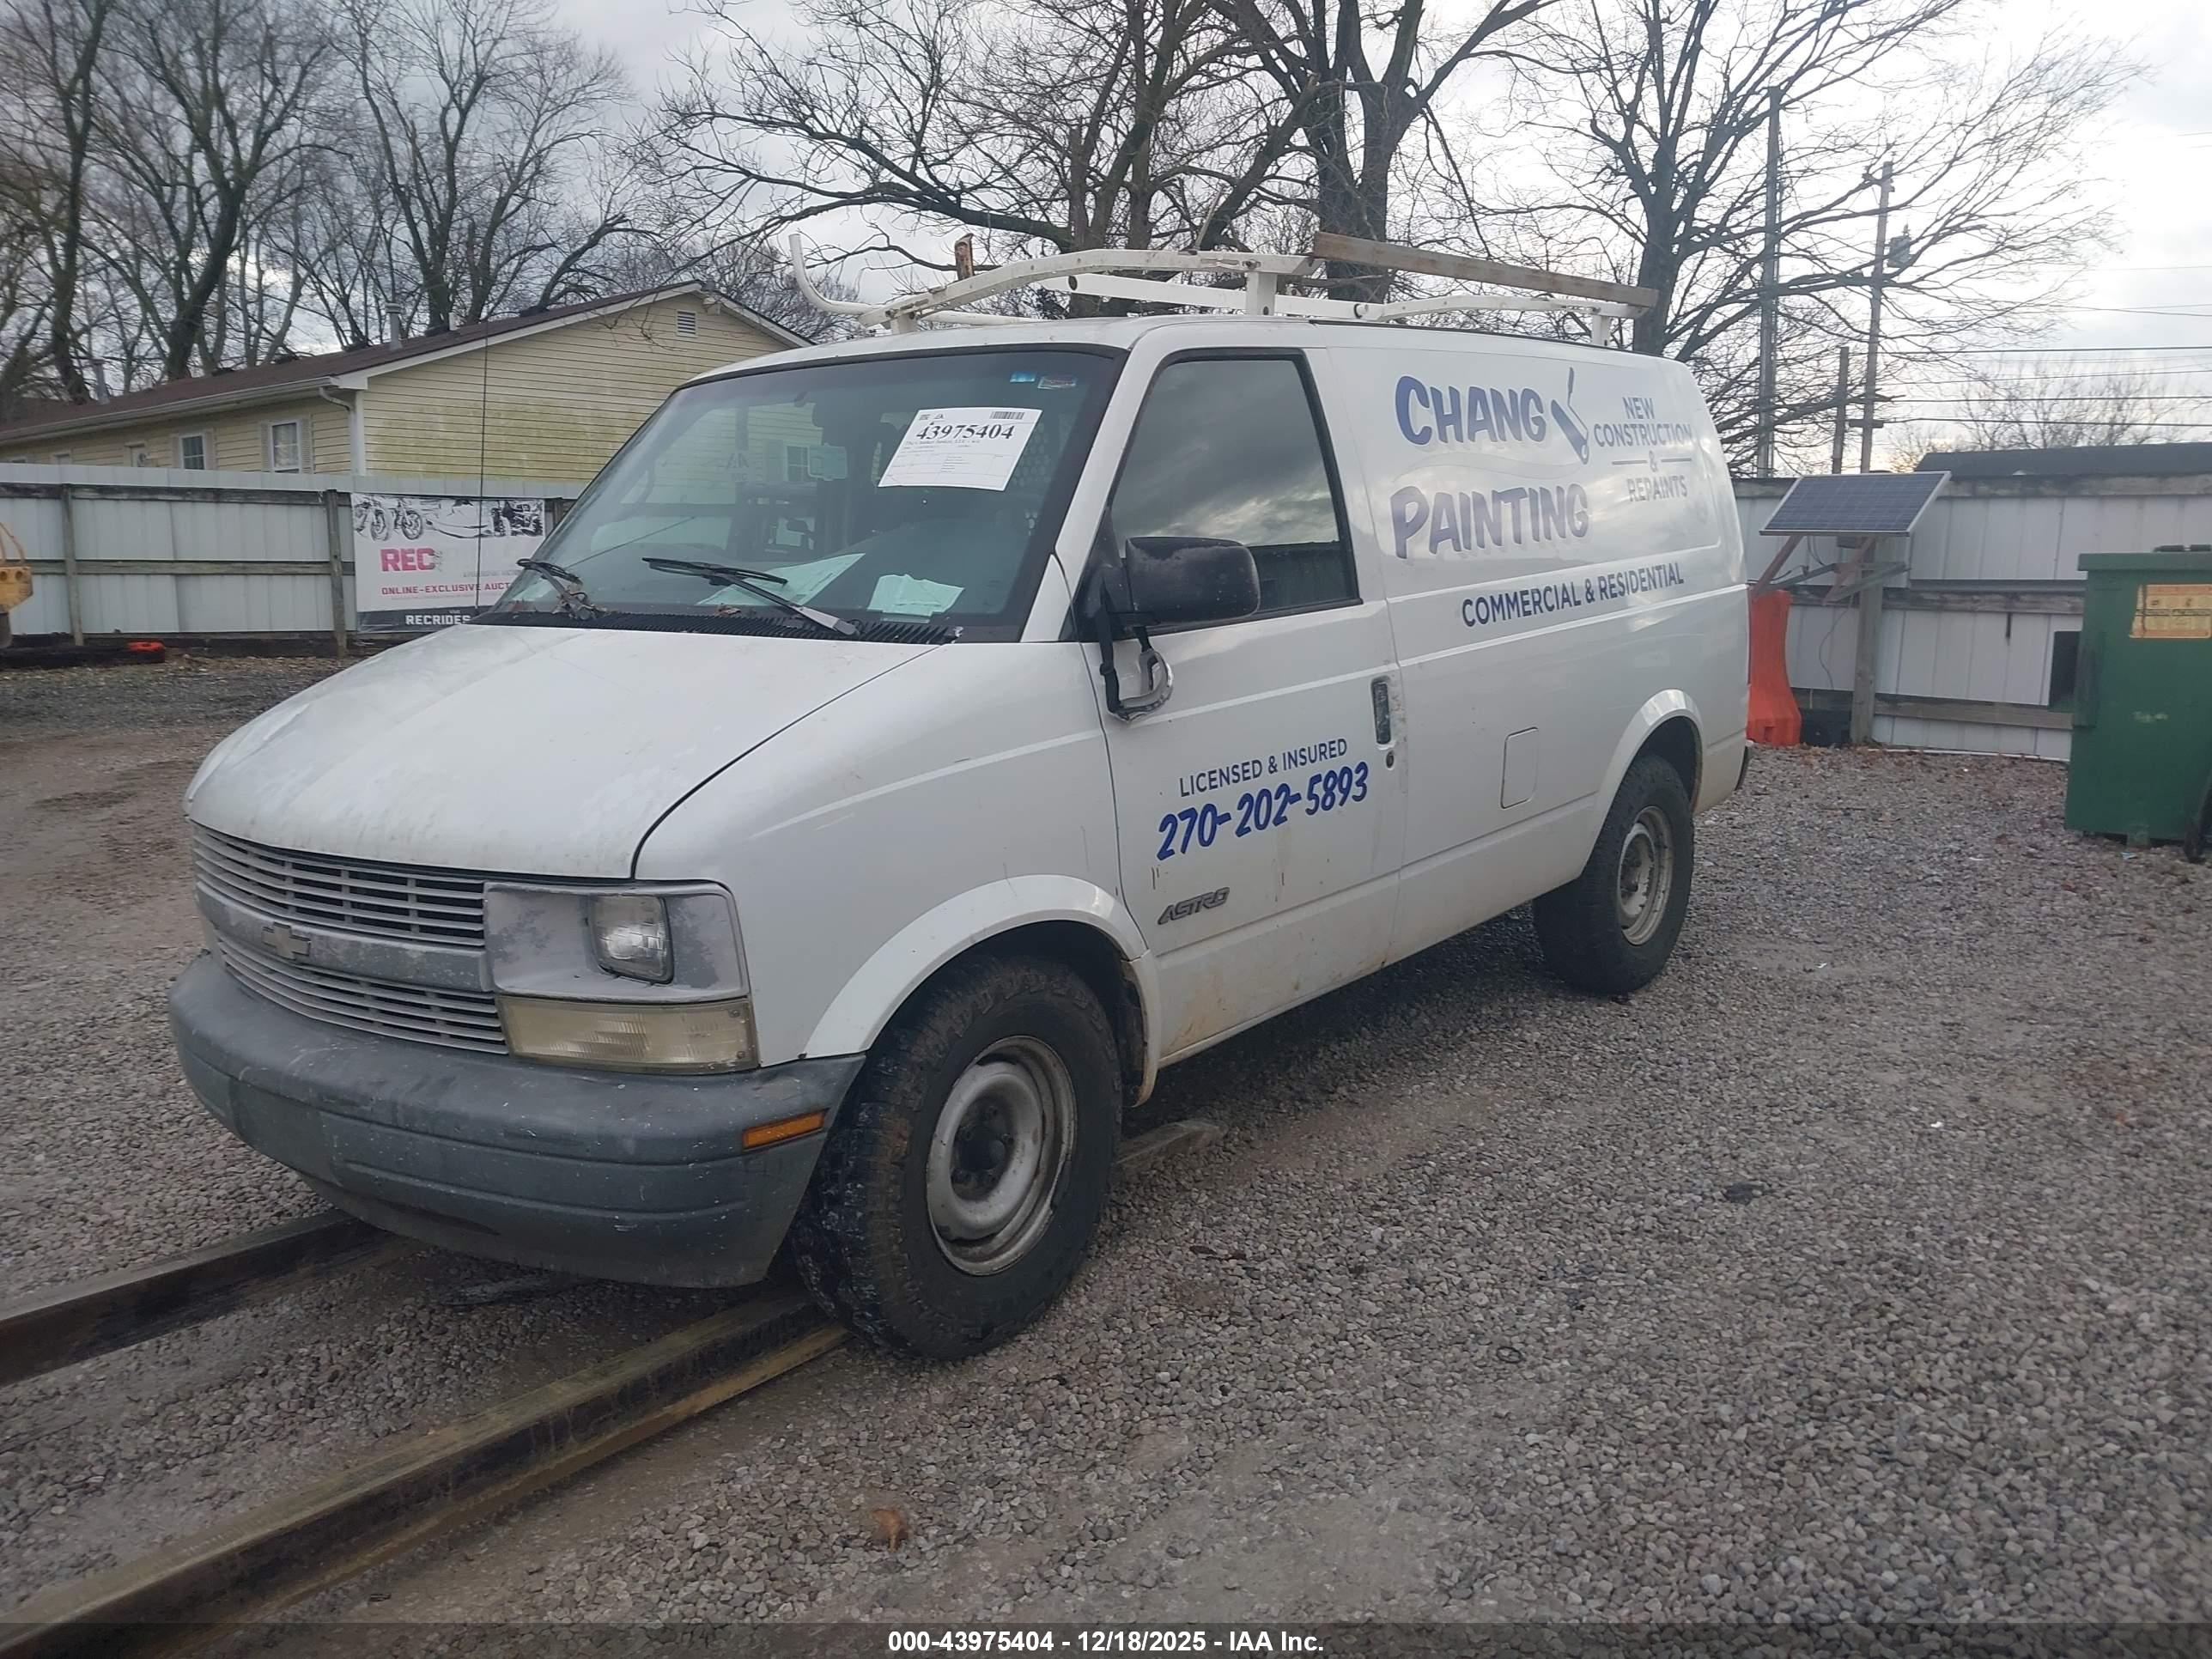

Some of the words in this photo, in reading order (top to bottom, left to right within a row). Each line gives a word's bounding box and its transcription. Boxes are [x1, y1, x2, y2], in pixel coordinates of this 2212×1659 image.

[1395, 376, 1547, 445] CHANG
[1622, 397, 1655, 419] NEW
[916, 422, 1015, 440] 43975404
[1594, 423, 1692, 447] CONSTRUCTION
[1648, 450, 1658, 472] &
[1626, 475, 1688, 501] REPAINTS
[1390, 483, 1589, 559] PAINTING
[1462, 580, 1582, 627] COMMERCIAL
[1585, 580, 1595, 604] &
[1598, 562, 1685, 598] RESIDENTIAL
[1179, 759, 1263, 797] LICENSED
[1268, 755, 1278, 775] &
[1283, 738, 1347, 771] INSURED
[1157, 762, 1369, 861] 270-202-5893
[1158, 887, 1230, 925] ASTRO
